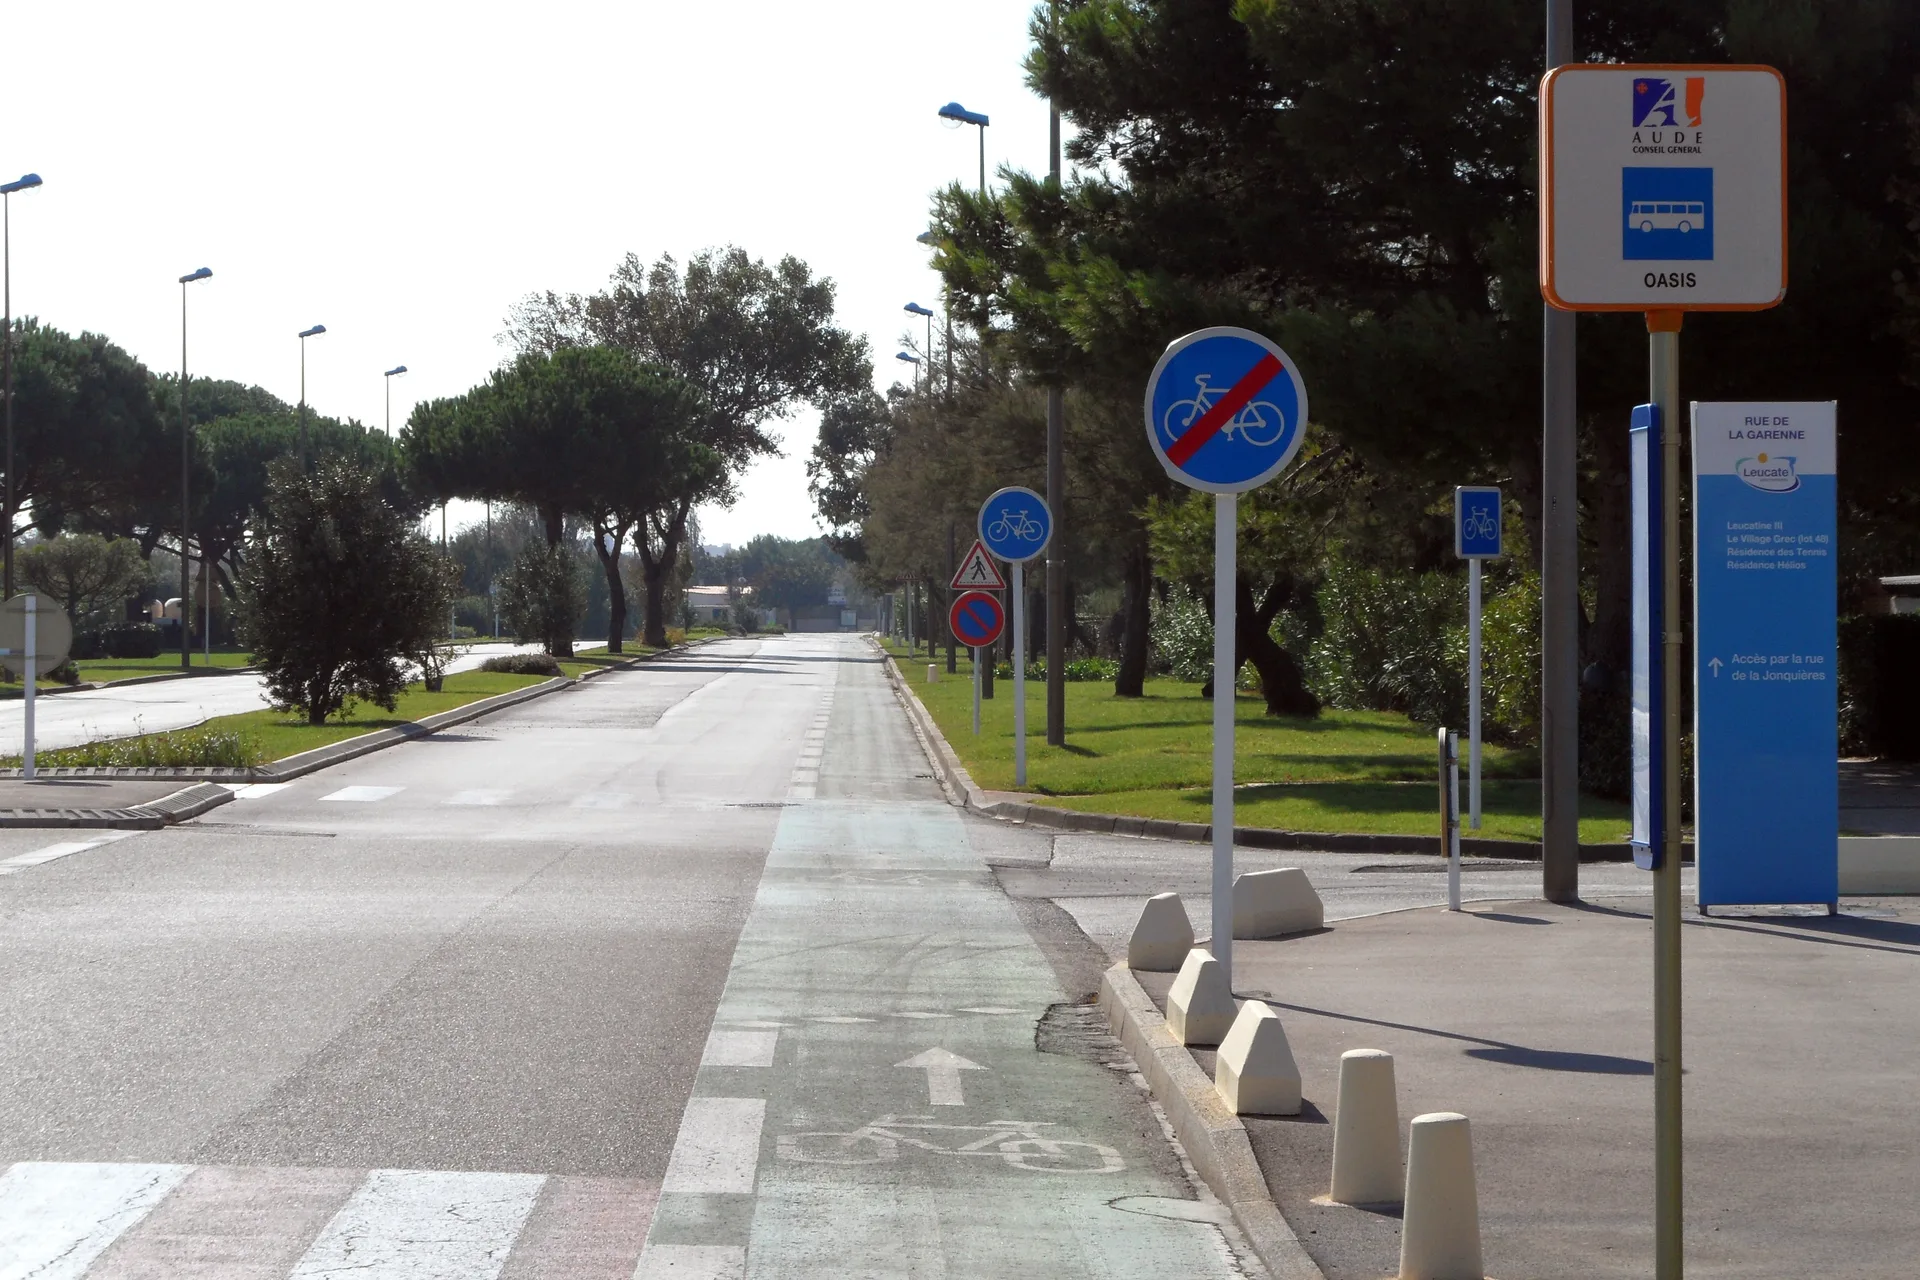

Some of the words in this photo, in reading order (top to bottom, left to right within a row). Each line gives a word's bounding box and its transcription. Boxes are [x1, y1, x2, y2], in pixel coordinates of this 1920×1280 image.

[1632, 131, 1703, 144] AUDE
[1632, 146, 1665, 154] CONSEIL
[1667, 146, 1702, 154] GENERAL
[1644, 272, 1697, 288] OASIS
[1745, 416, 1770, 426] RUE
[1773, 416, 1789, 426] DE
[1729, 430, 1744, 439] LA
[1747, 430, 1805, 440] GARENNE
[1743, 467, 1789, 477] Leucate
[1727, 521, 1772, 530] Leucatine
[1727, 535, 1738, 543] Le
[1741, 535, 1771, 544] Village
[1773, 535, 1796, 543] Grec
[1798, 534, 1813, 544] (lot
[1727, 547, 1775, 556] Résidence
[1777, 548, 1794, 556] des
[1797, 548, 1827, 556] Tennis
[1731, 653, 1767, 664] Accès
[1770, 655, 1789, 666] par
[1792, 653, 1802, 664] la
[1805, 655, 1824, 664] rue
[1731, 670, 1747, 680] de
[1749, 670, 1760, 680] la
[1762, 670, 1826, 682] Jonquières
